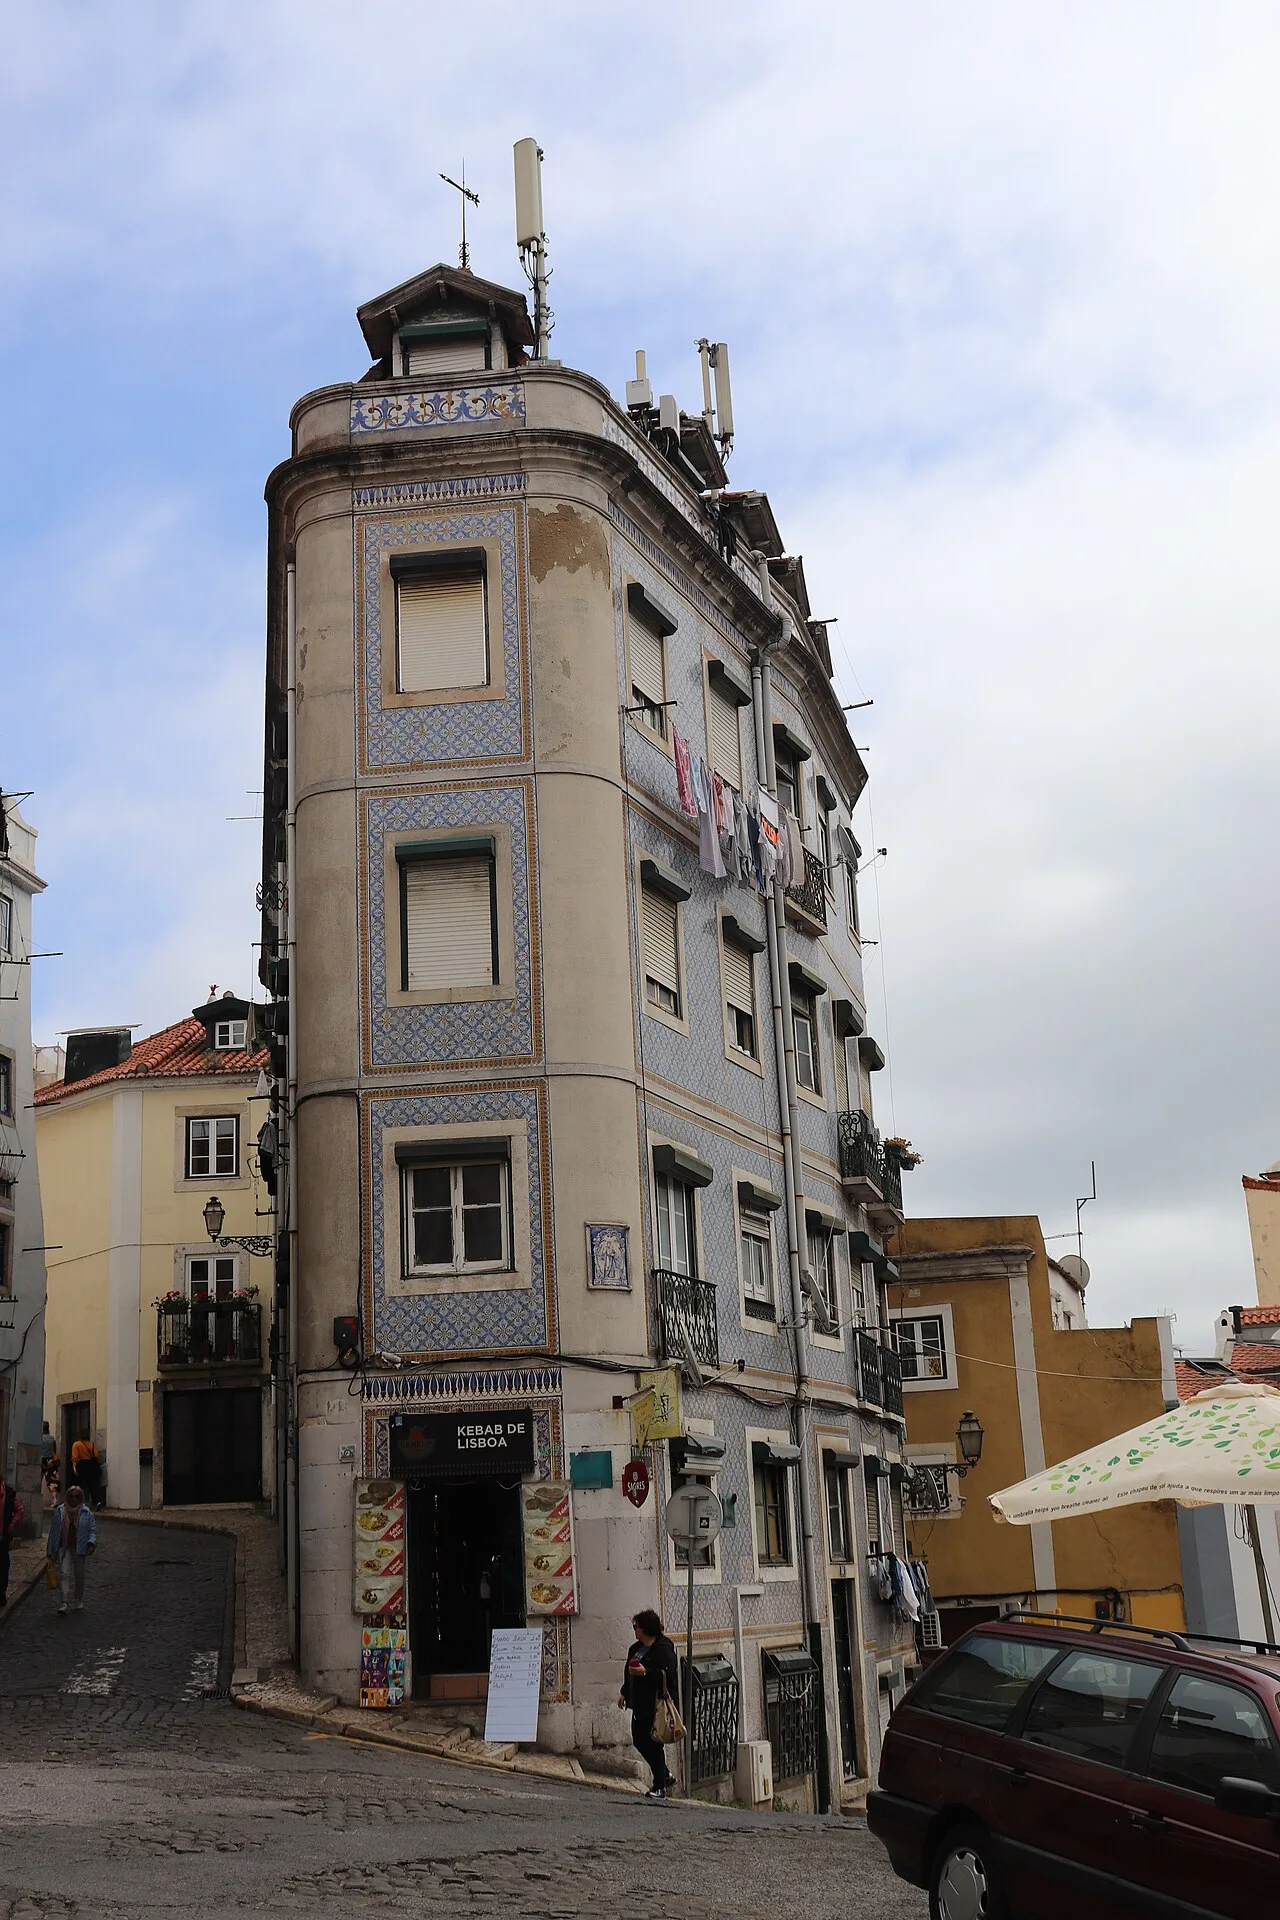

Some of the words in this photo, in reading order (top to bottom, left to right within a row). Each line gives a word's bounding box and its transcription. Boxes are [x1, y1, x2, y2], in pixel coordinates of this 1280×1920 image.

[457, 1424, 503, 1437] KEBAB
[507, 1423, 526, 1434] DE
[457, 1437, 508, 1449] LISBOA
[627, 1481, 645, 1492] SAGRES
[1203, 1487, 1228, 1495] respires
[1263, 1489, 1280, 1497] limpo
[1012, 1509, 1034, 1519] umbrella
[1034, 1506, 1049, 1515] helps
[1061, 1501, 1081, 1510] breathe
